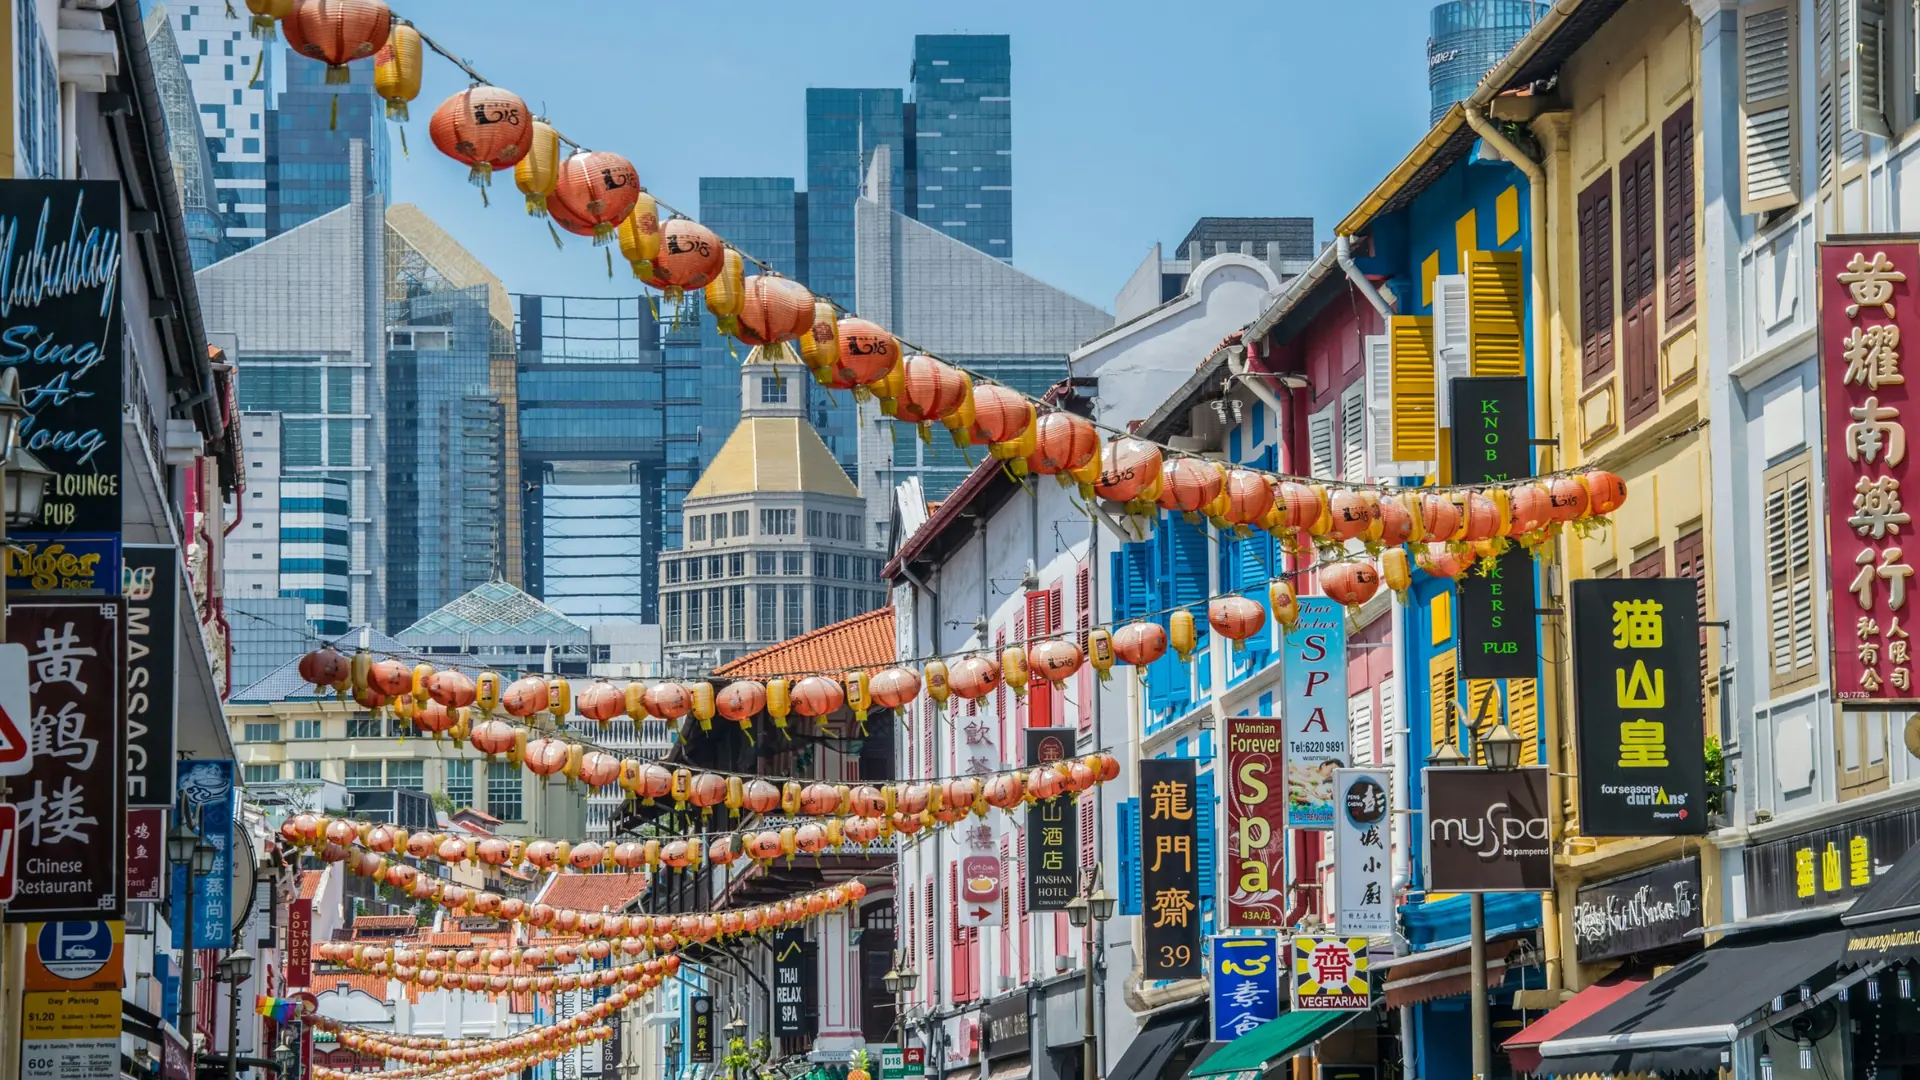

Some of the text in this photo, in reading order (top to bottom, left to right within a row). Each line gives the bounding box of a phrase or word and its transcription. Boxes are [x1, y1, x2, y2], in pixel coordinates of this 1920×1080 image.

[0, 325, 103, 379] Sing
[1481, 400, 1500, 461] KNOB
[56, 473, 118, 496] LOUNGE
[44, 503, 75, 525] PUB
[5, 543, 101, 590] Tiger
[61, 578, 95, 588] Beer
[1490, 560, 1505, 628] KERS
[1298, 601, 1331, 613] Thai
[1294, 617, 1336, 629] Relax
[1483, 642, 1518, 654] PUB
[1301, 635, 1330, 732] SPA
[1612, 599, 1669, 767] 猫山皇
[128, 607, 150, 798] MASSAGE
[17, 621, 99, 847] 黄鹤楼
[1235, 723, 1275, 733] Wannian
[1230, 735, 1281, 753] Forever
[1325, 741, 1345, 752] 9891
[964, 720, 994, 849] 飲茶樓
[1618, 785, 1659, 794] seasons
[1239, 762, 1271, 892] Spa
[1042, 802, 1063, 869] 山酒店
[1150, 780, 1195, 928] 龍門齋
[1514, 848, 1549, 857] pampered
[26, 858, 82, 875] Chinese
[16, 878, 93, 896] Restaurant
[1034, 876, 1072, 884] JINSHAN
[1038, 888, 1069, 896] HOTEL
[1242, 911, 1271, 919] 43A/B
[292, 911, 300, 966] GOLDEN
[1160, 945, 1191, 968] 39
[779, 968, 798, 983] THAI
[67, 997, 99, 1005] Parking
[777, 987, 801, 1002] RELAX
[1300, 996, 1367, 1008] VEGETARIAN
[28, 1012, 55, 1021] $1.20
[782, 1006, 797, 1021] SPA
[28, 1058, 54, 1069] 60¢
[885, 1057, 901, 1065] D18
